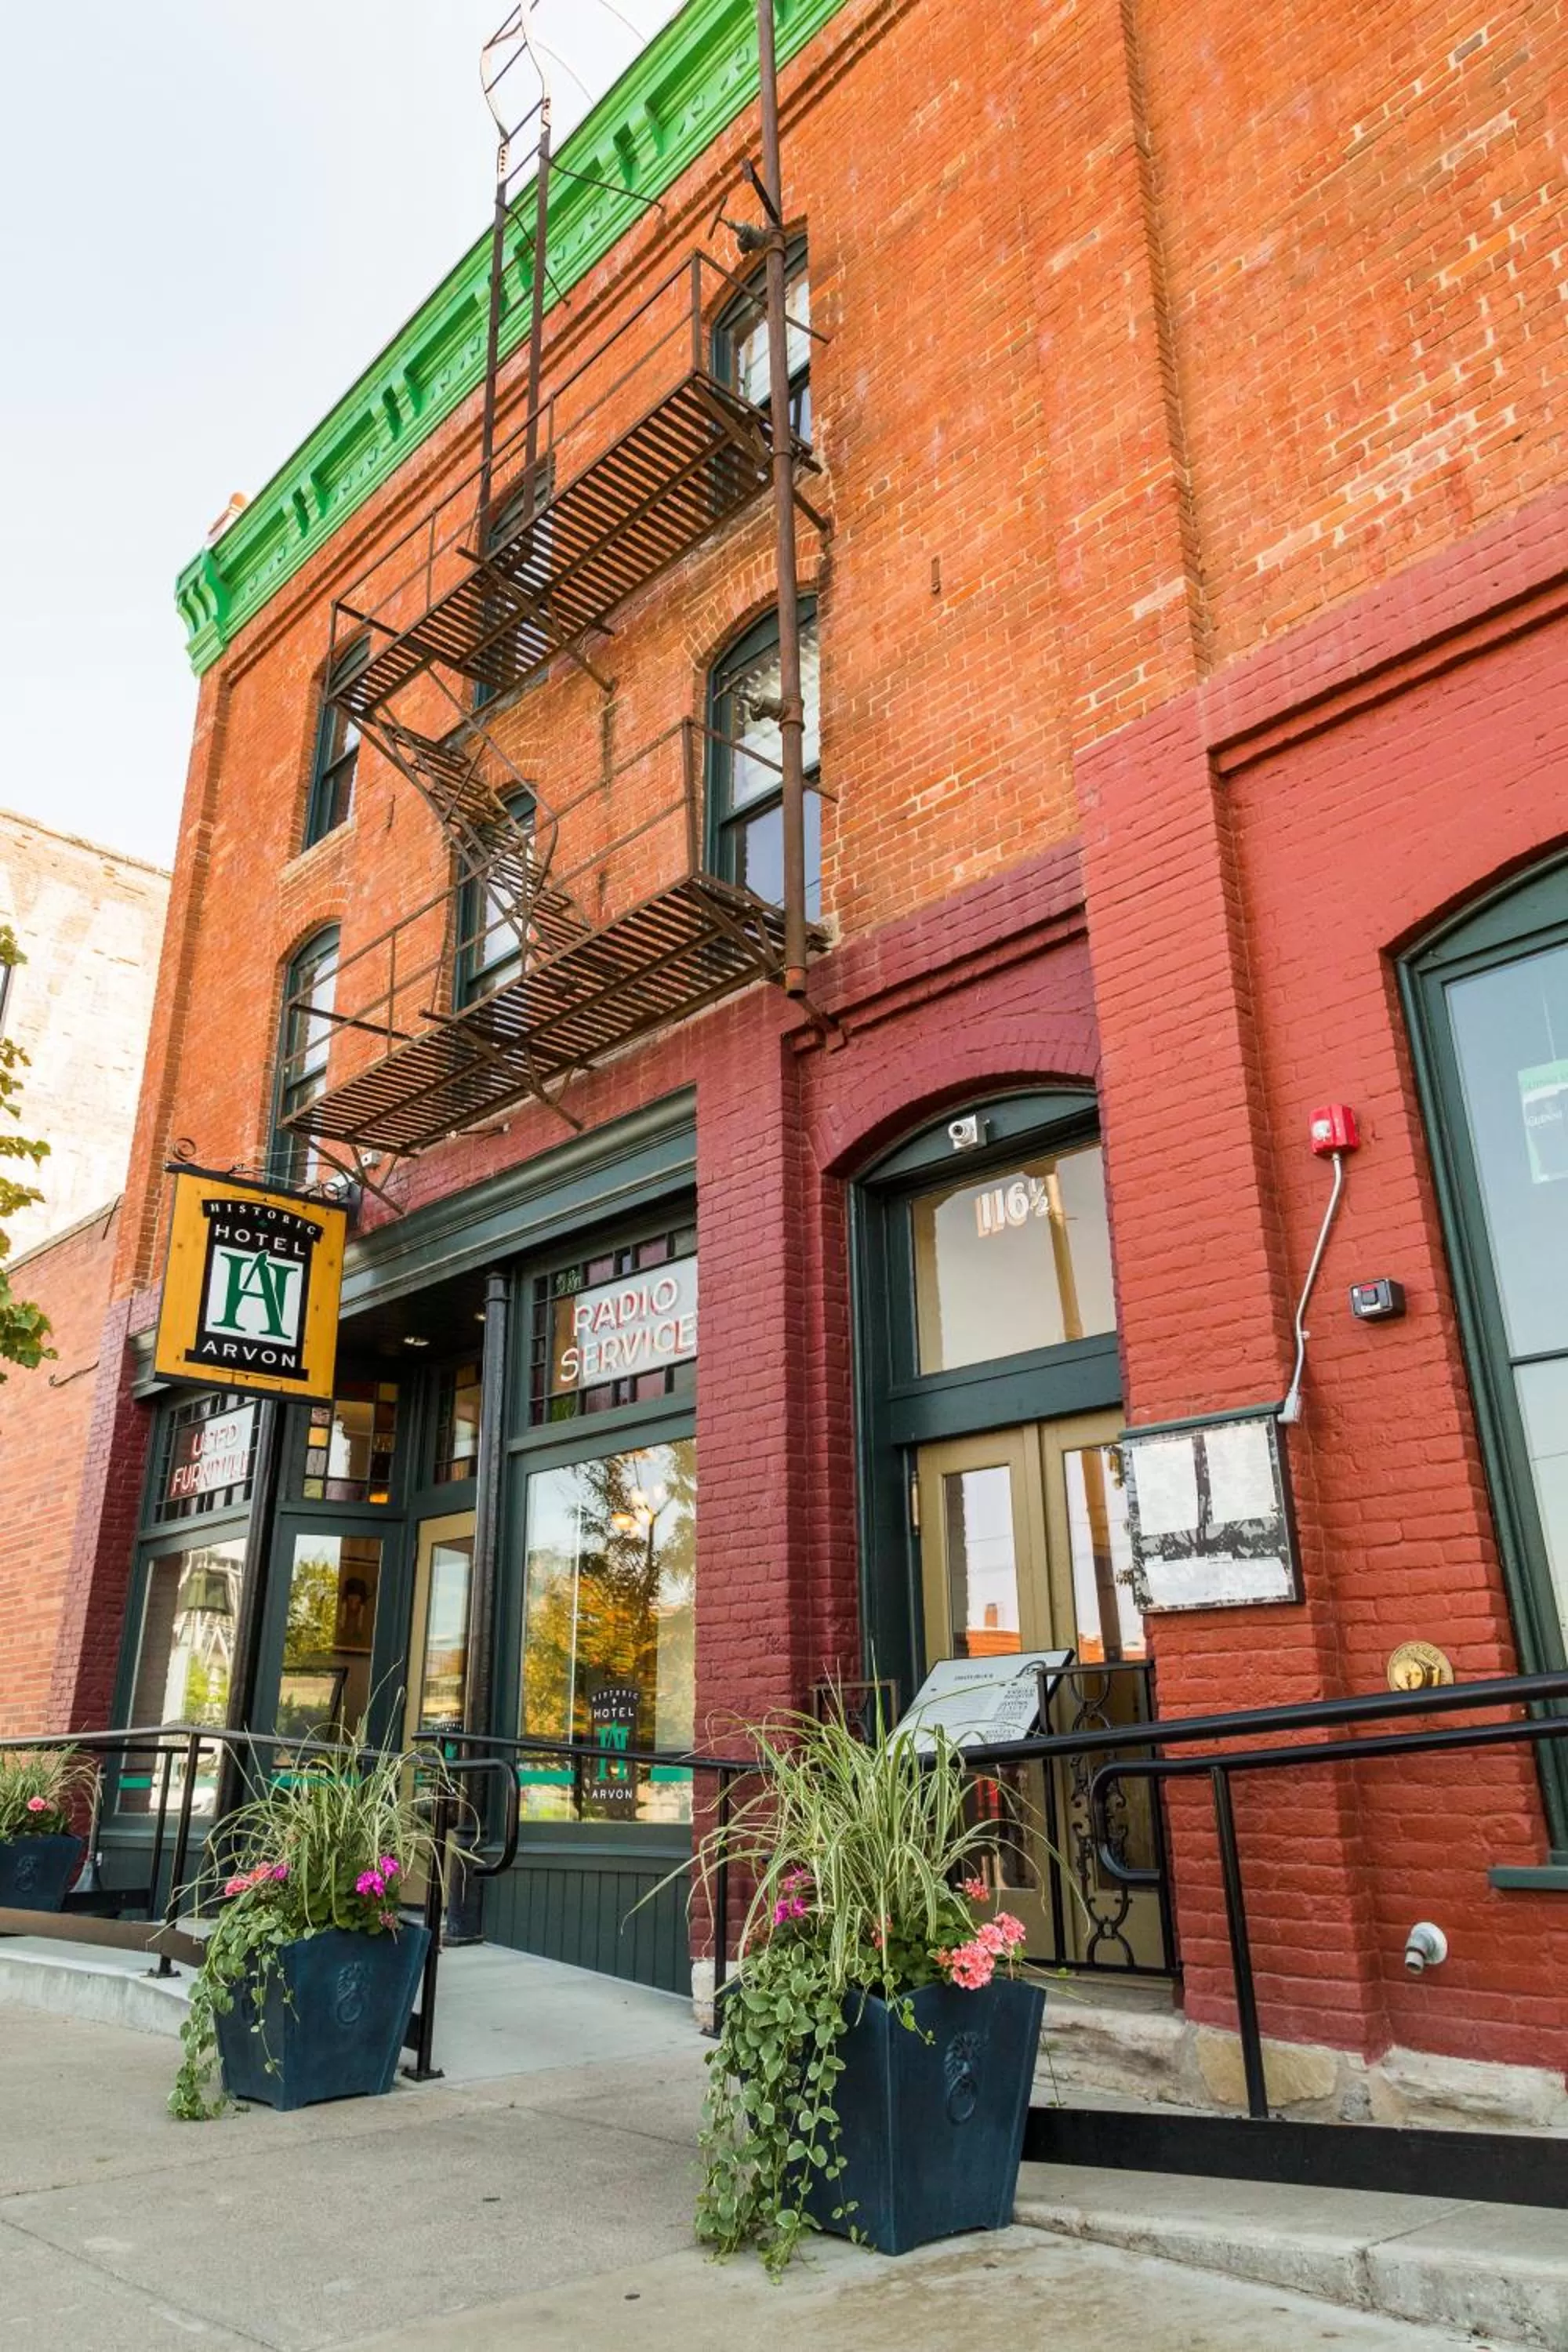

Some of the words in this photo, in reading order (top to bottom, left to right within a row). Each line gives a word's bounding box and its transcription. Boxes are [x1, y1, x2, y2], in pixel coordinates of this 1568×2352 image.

[210, 1203, 316, 1236] HISTORIC
[214, 1224, 306, 1256] HOTEL
[572, 1277, 677, 1336] RADIO
[201, 1340, 296, 1368] ARVON
[561, 1311, 696, 1382] SERVICE
[593, 1707, 634, 1719] HOTEL
[592, 1788, 633, 1799] ARVON
